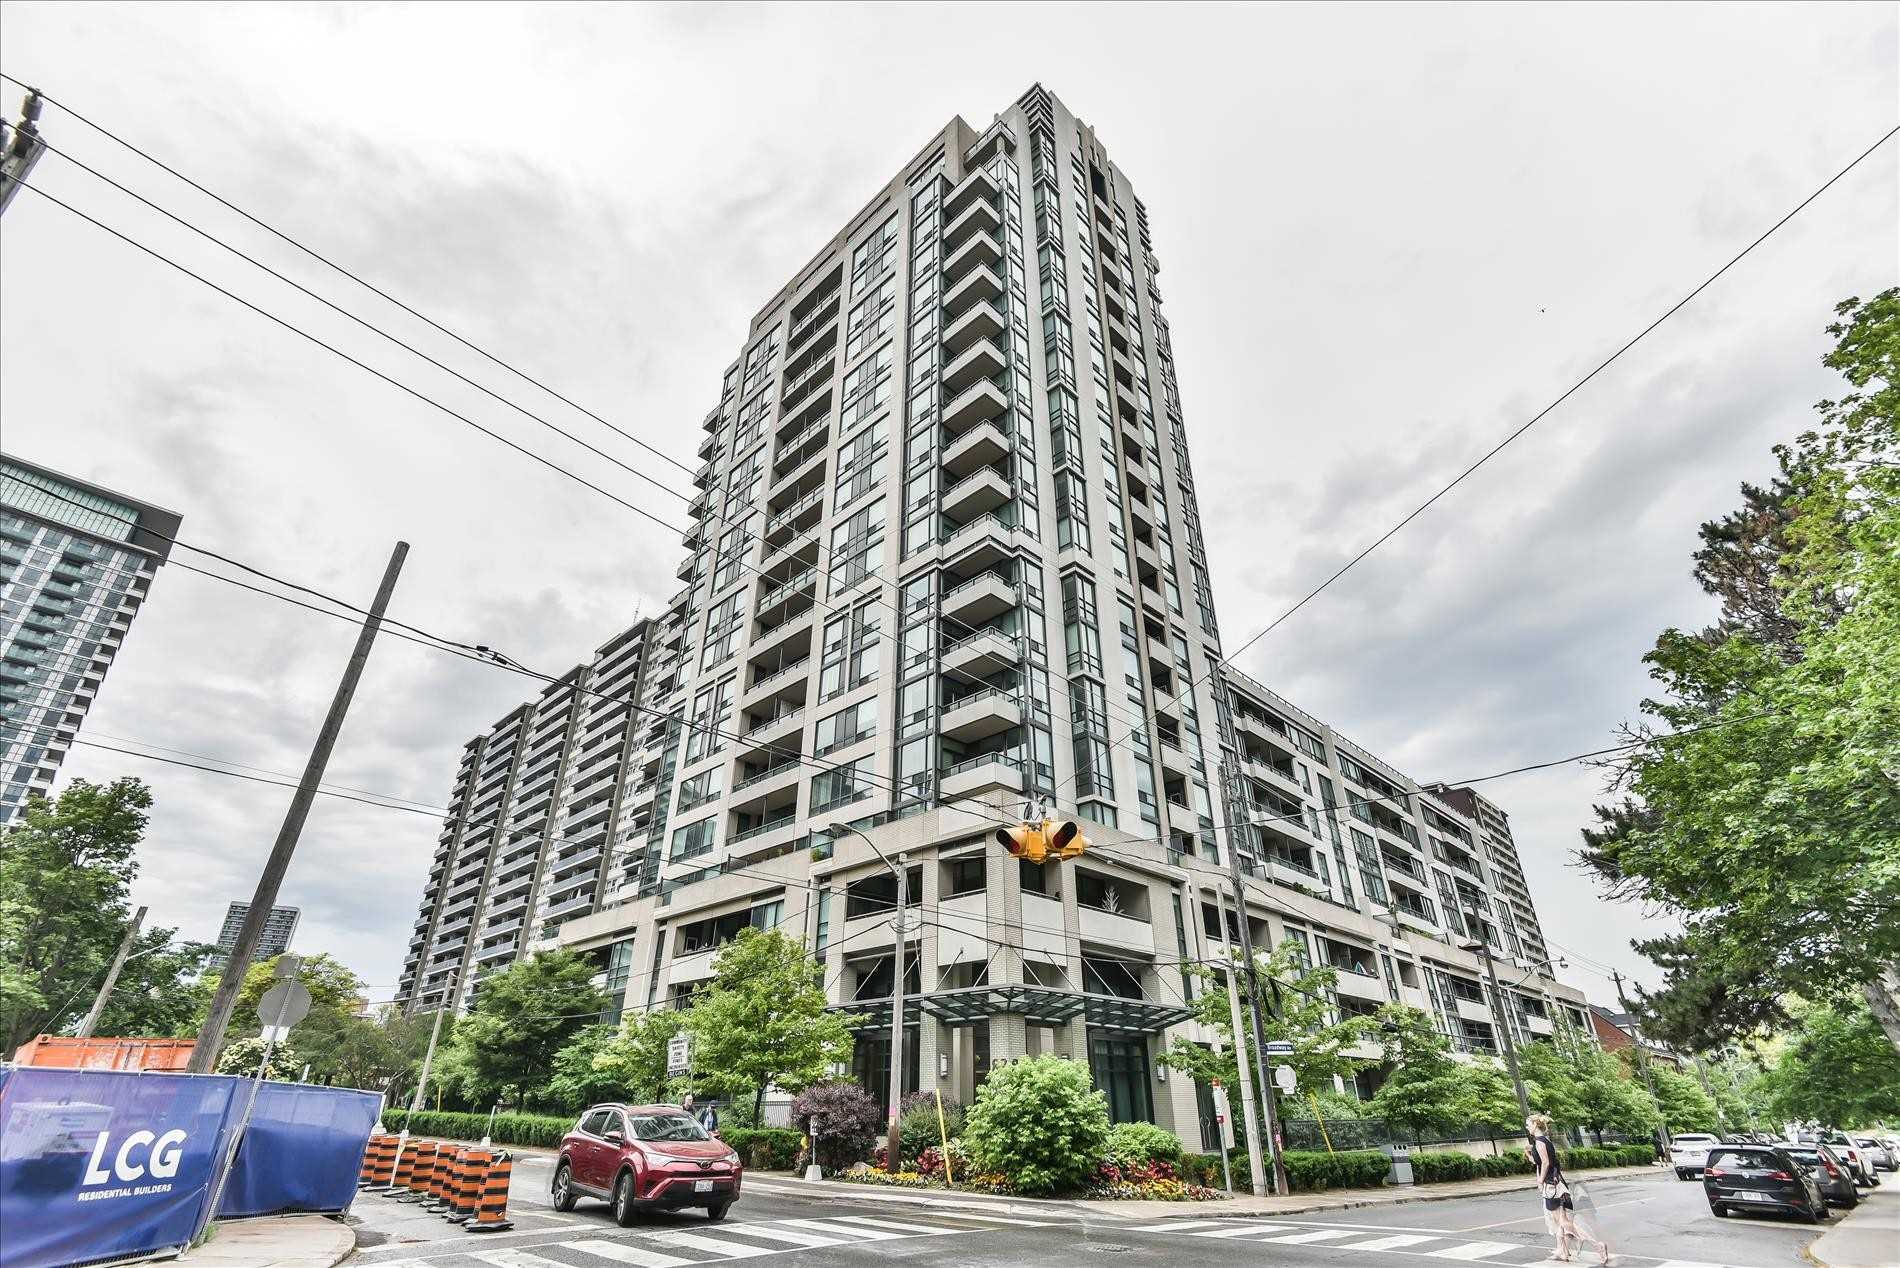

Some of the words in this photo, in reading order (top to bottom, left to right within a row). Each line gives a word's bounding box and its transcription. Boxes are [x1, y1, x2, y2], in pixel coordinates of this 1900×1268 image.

[82, 1129, 187, 1185] LCG
[78, 1188, 132, 1201] RESIDENTIAL
[134, 1184, 172, 1195] BUILDERS
